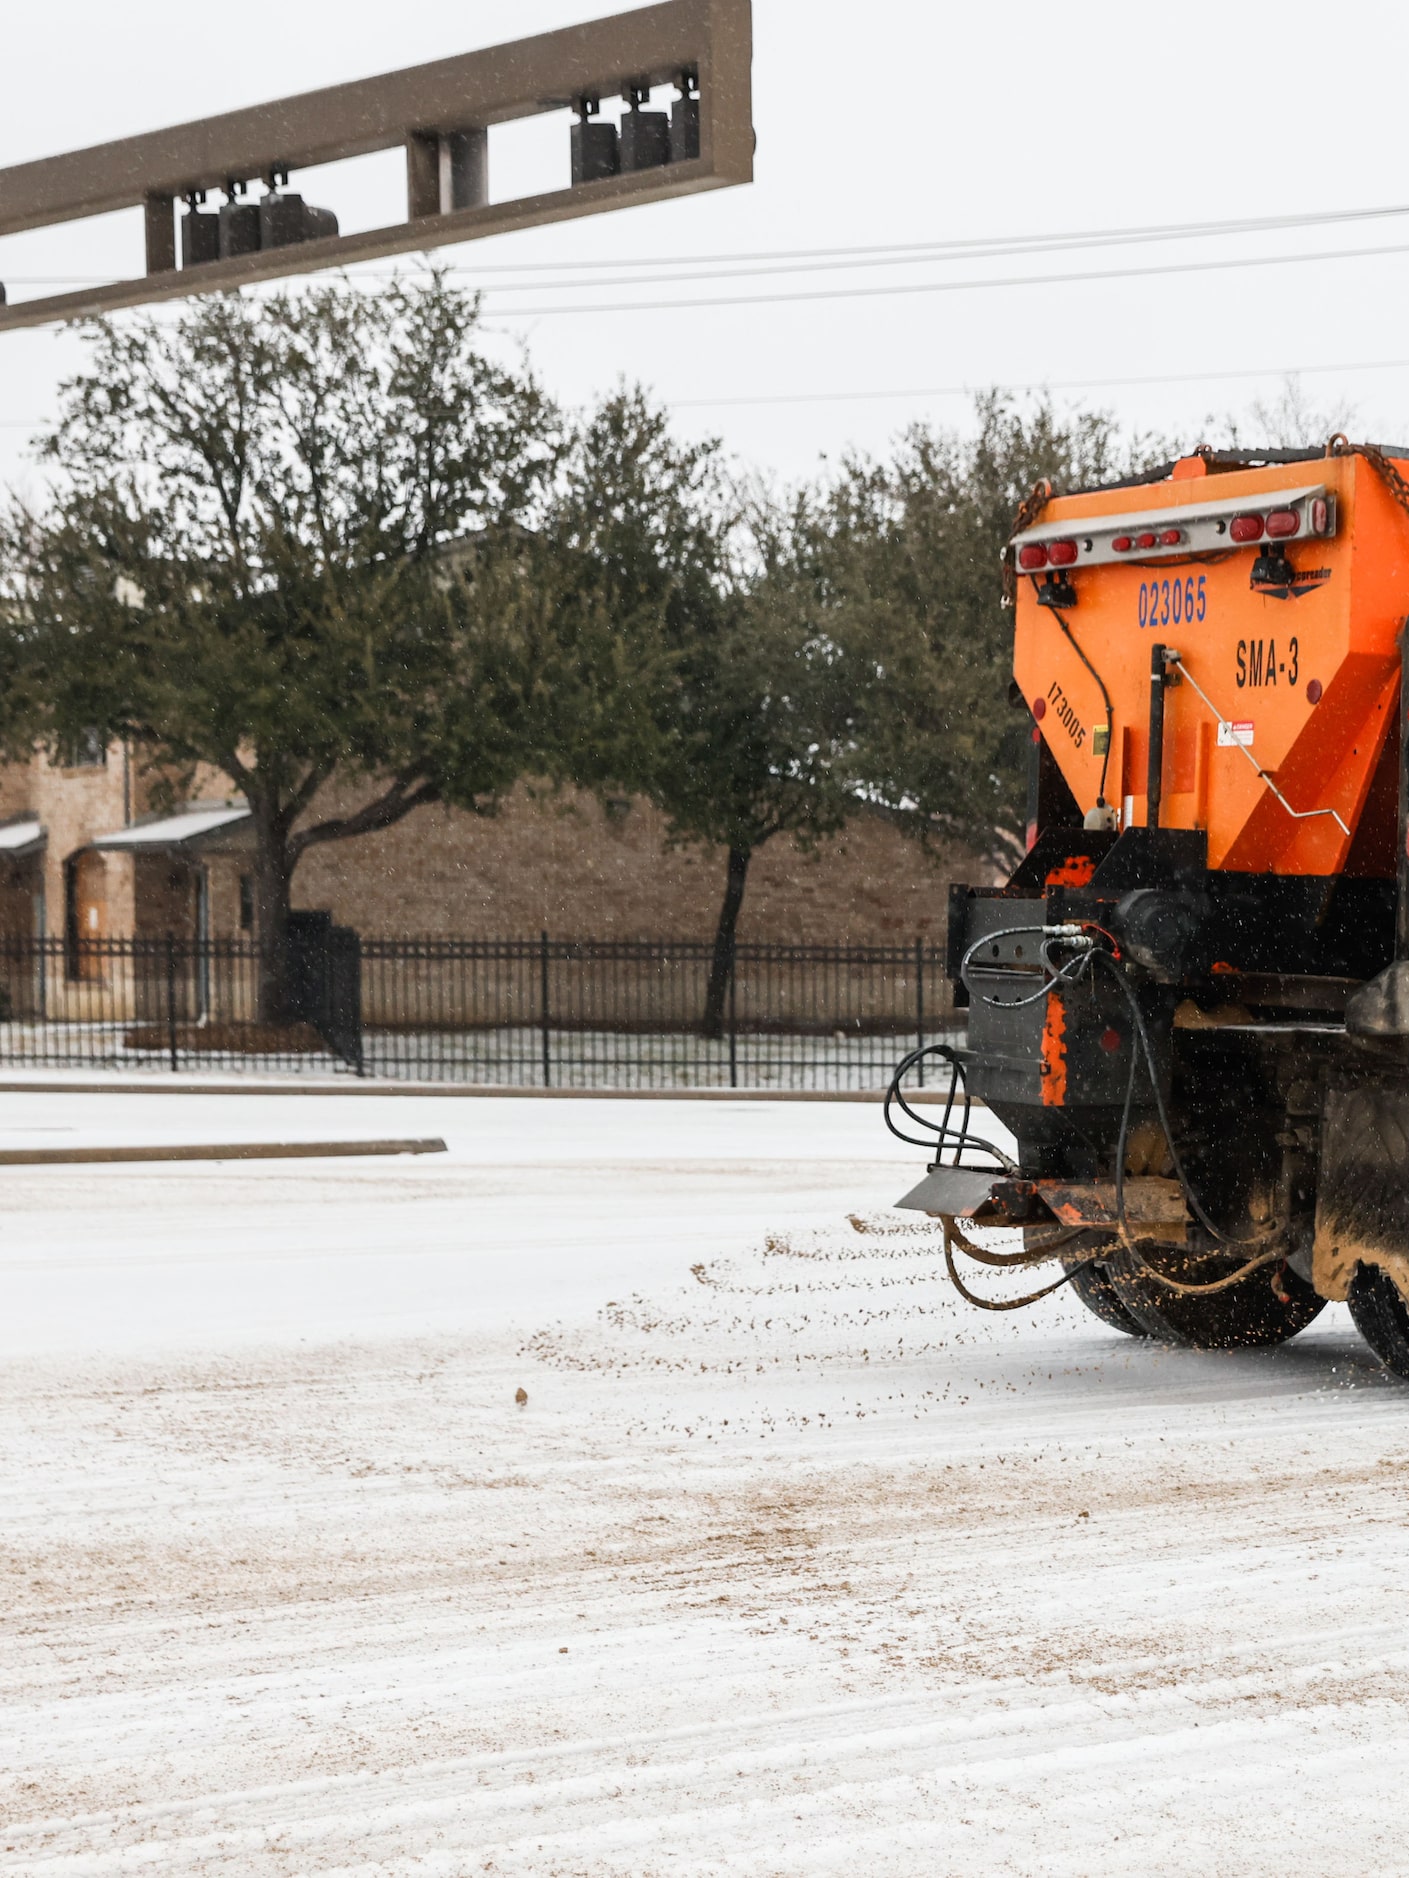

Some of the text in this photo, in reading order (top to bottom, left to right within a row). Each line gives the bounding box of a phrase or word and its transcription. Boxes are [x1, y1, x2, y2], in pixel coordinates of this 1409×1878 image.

[1138, 575, 1207, 628] 023065
[1236, 637, 1299, 688] SMA-3
[1047, 681, 1086, 749] 173005
